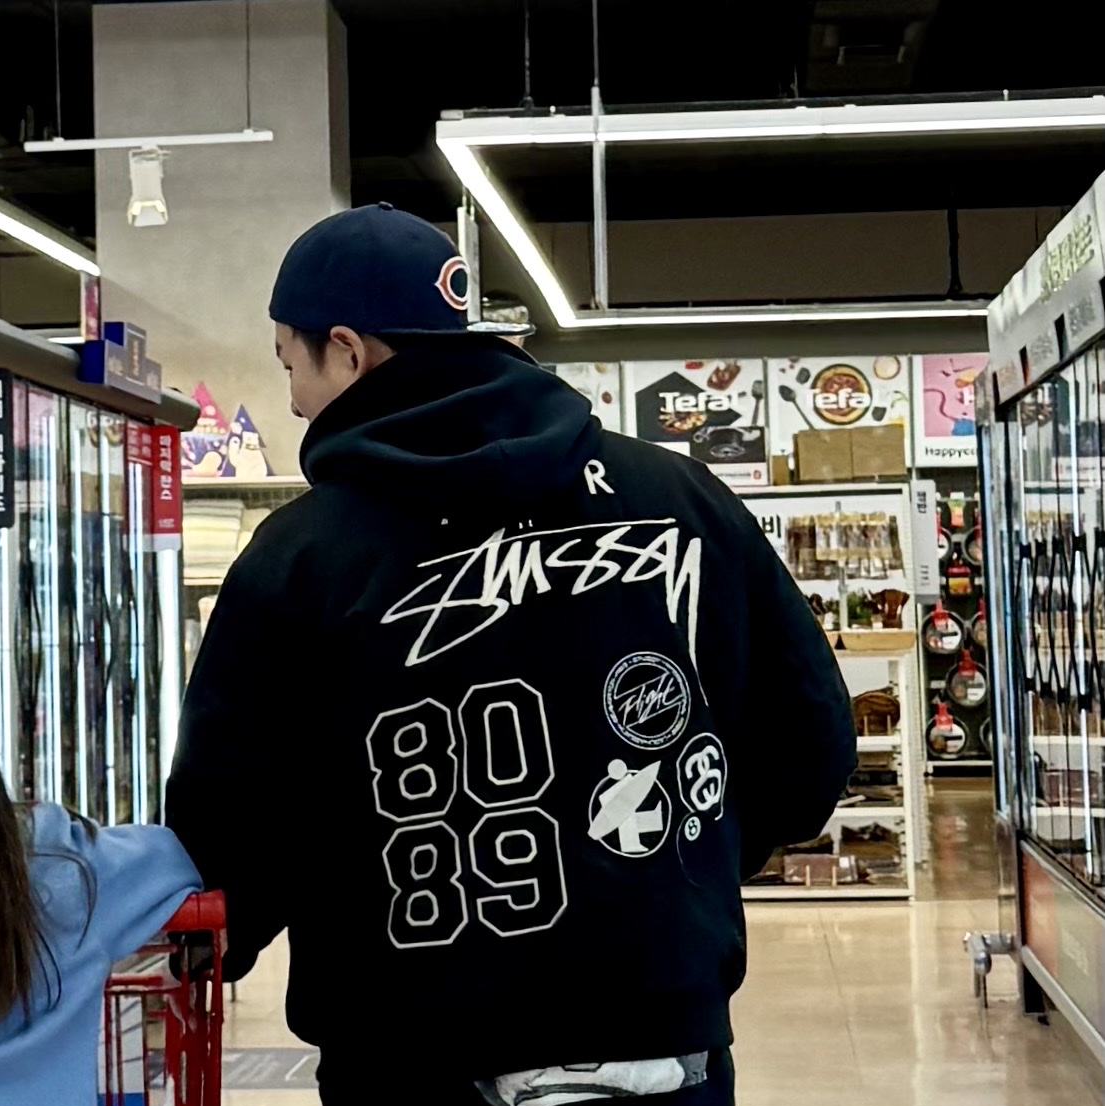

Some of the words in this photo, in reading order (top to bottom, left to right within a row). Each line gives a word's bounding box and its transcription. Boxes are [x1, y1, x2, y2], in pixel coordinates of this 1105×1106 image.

[583, 459, 614, 497] R
[365, 677, 556, 823] 80
[381, 806, 568, 951] 89
